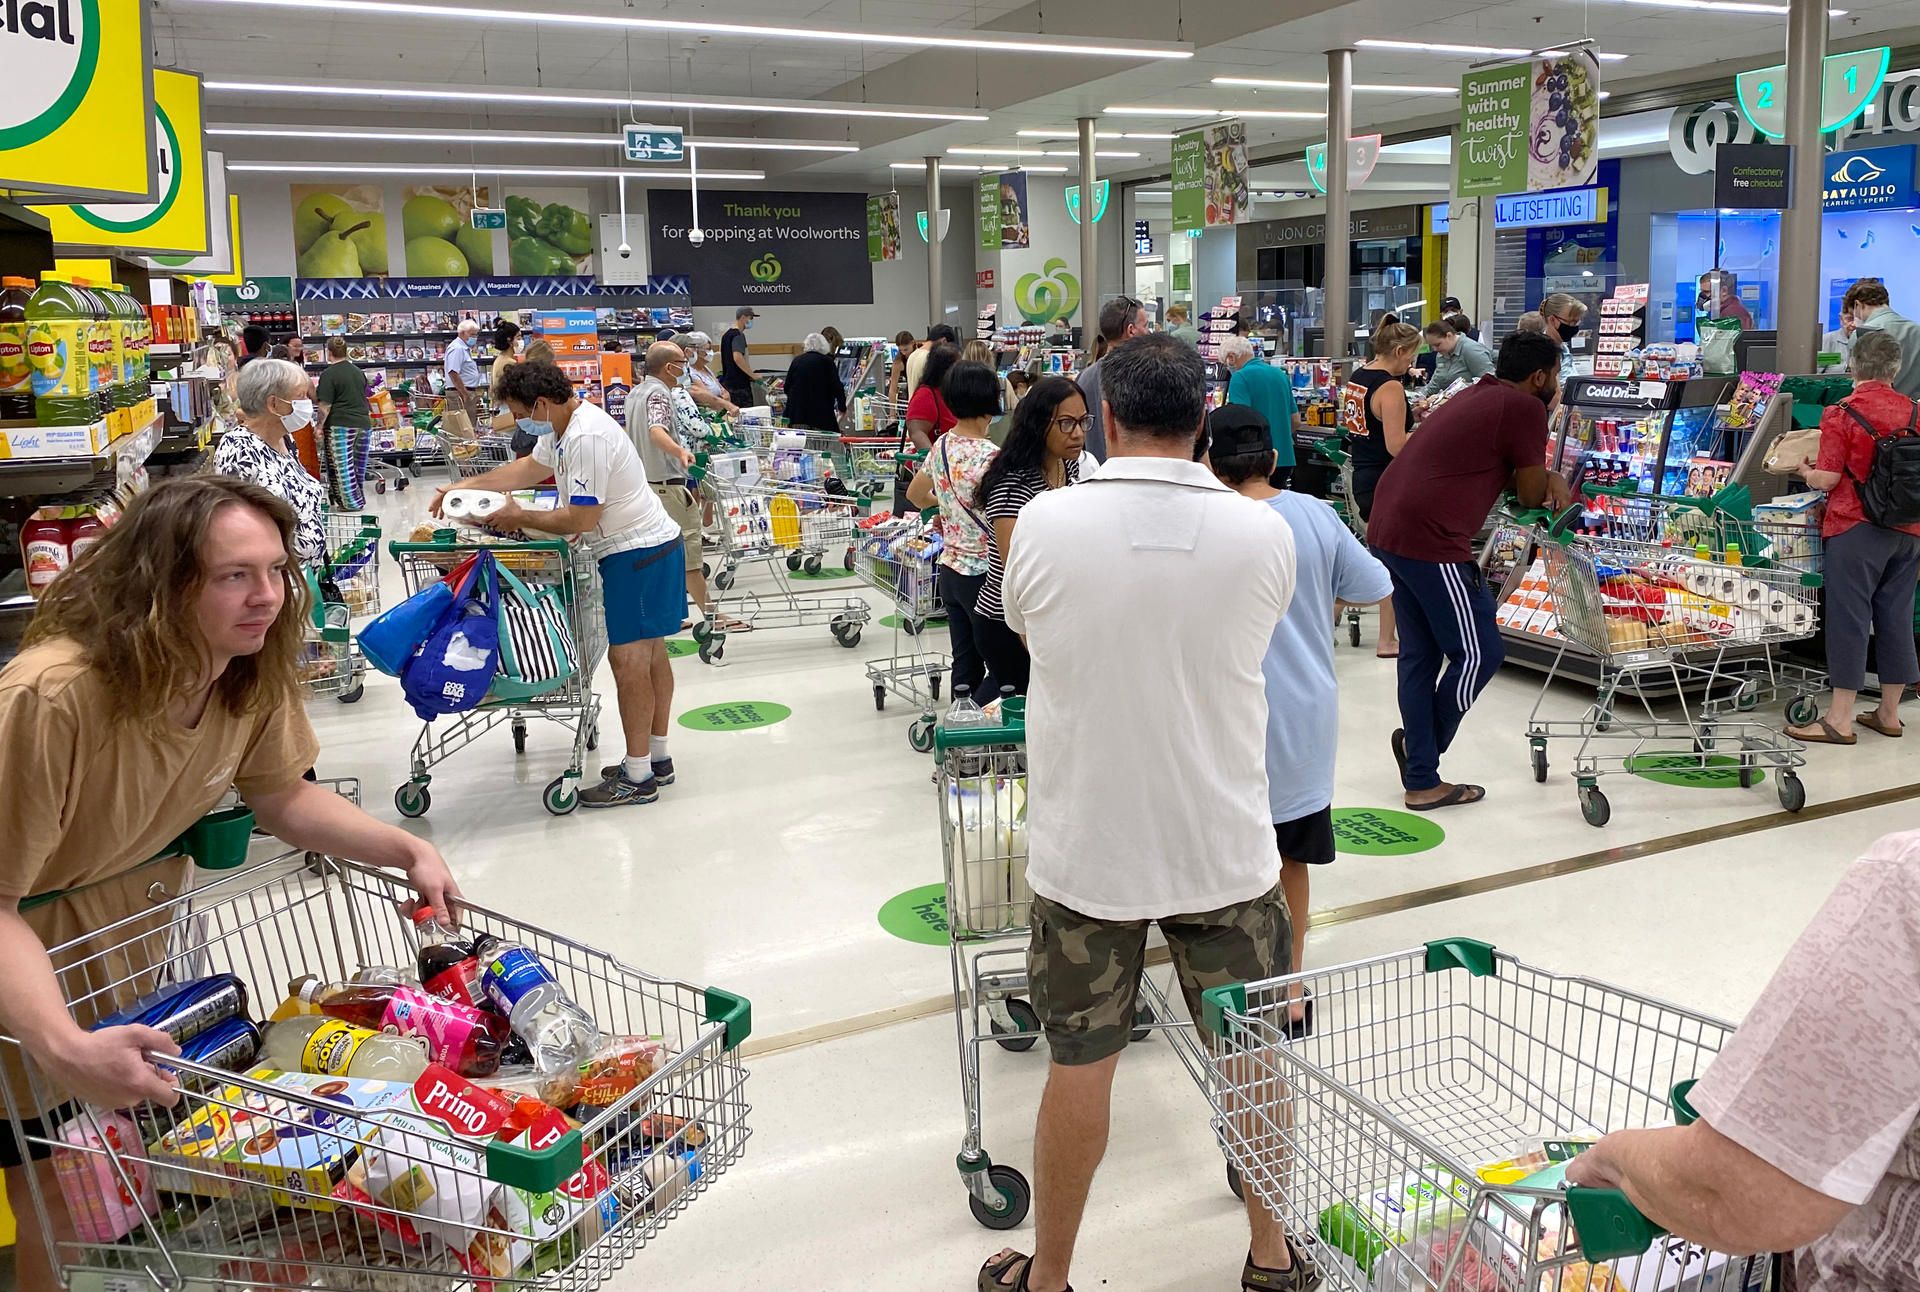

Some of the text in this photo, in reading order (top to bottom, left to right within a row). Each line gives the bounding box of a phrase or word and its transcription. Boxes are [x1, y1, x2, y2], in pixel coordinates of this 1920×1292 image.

[0, 0, 75, 45] ial
[1467, 76, 1526, 96] Summer
[1844, 65, 1857, 94] 1
[1757, 82, 1774, 108] 2
[1467, 98, 1510, 115] with a
[1466, 114, 1520, 133] healthy
[1174, 140, 1199, 152] A healthy
[1460, 131, 1523, 169] twist
[1315, 153, 1324, 171] 4
[1356, 147, 1366, 165] 3
[1173, 155, 1200, 178] twist
[1733, 167, 1784, 177] Confectionery
[981, 183, 998, 192] Summer
[1174, 182, 1185, 191] with
[1733, 178, 1784, 188] free checkout
[1072, 194, 1080, 208] 6
[1095, 189, 1102, 204] 5
[1822, 199, 1855, 207] EARING
[724, 203, 801, 220] Thank you
[1508, 195, 1582, 223] JETSETTING
[662, 225, 860, 242] for opping at Woolworths
[1277, 225, 1303, 241] JON
[742, 283, 791, 293] Woolworths
[0, 346, 20, 355] pton
[30, 345, 50, 354] Lipton
[1586, 386, 1644, 399] Cold Dri
[11, 435, 40, 448] Light
[443, 686, 464, 697] BAG
[445, 682, 465, 690] COOL
[1336, 817, 1401, 845] stand
[1352, 812, 1420, 843] Please
[912, 902, 949, 932] here
[318, 1032, 344, 1071] SOLO
[584, 1086, 627, 1098] CHILLI
[423, 1080, 487, 1133] Primo
